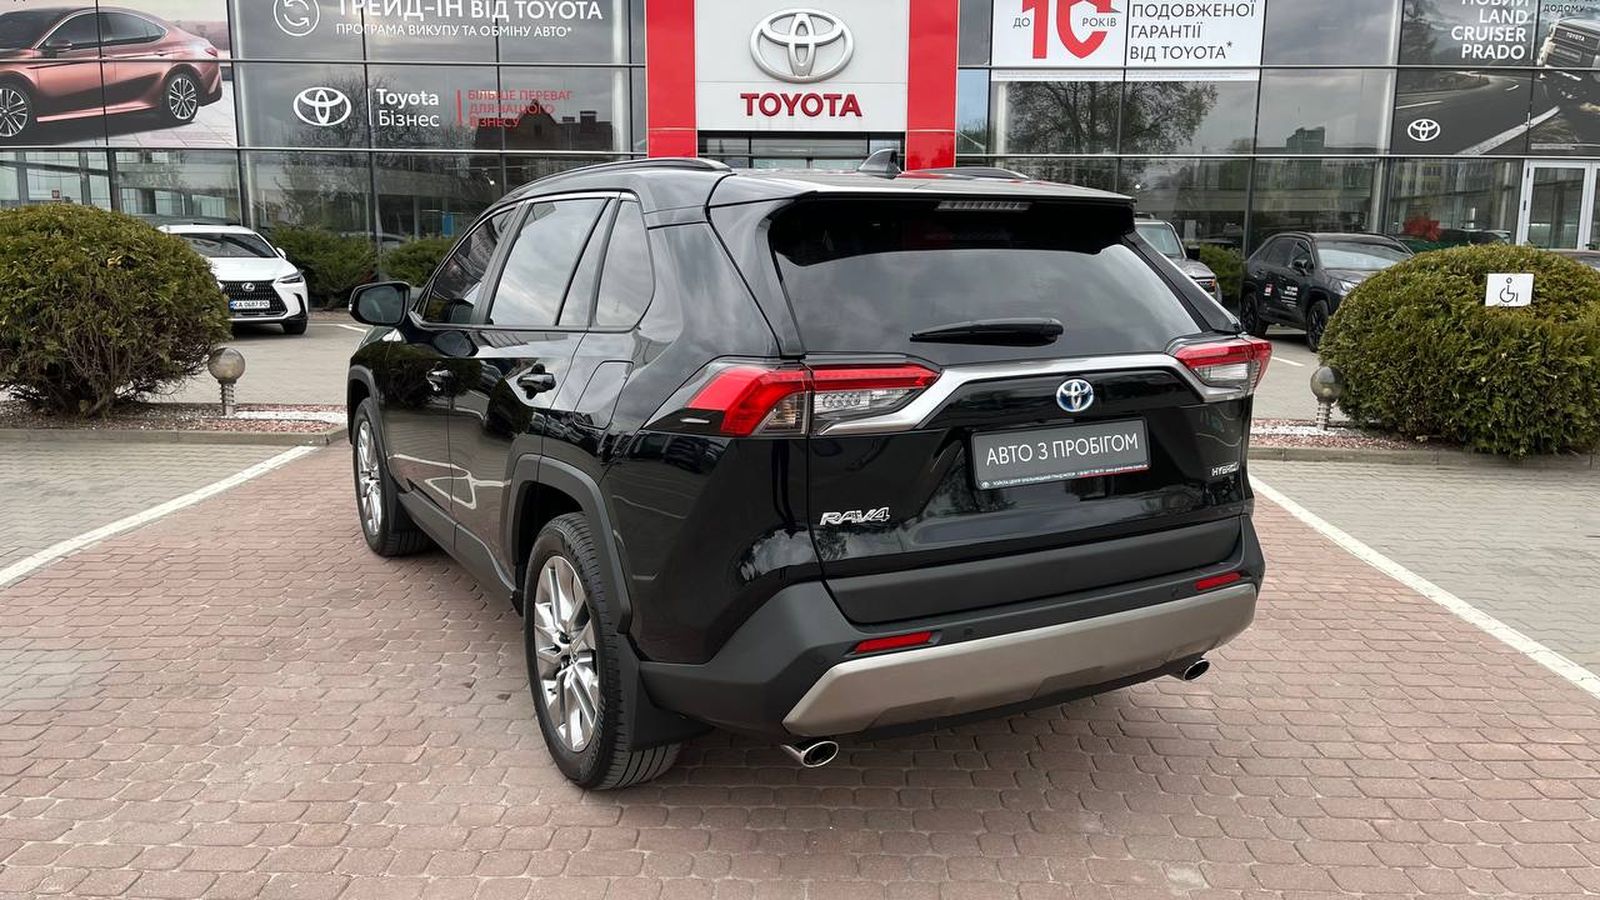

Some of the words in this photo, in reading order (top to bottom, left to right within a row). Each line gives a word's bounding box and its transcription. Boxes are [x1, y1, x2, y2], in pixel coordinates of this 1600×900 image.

[471, 0, 510, 23] ВІД
[514, 1, 603, 20] TOYOTA
[1132, 0, 1257, 20] ПОДОВЖЕНОЇ
[1479, 8, 1528, 24] LAND
[336, 23, 405, 36] ПРОГРАМА
[408, 24, 460, 36] ВИКУПУ
[461, 25, 477, 36] ТА
[479, 25, 532, 37] ОБМІНУ
[1013, 18, 1031, 29] ДО
[1082, 17, 1117, 27] РОКІВ
[1130, 22, 1204, 39] ГАРАНТІЇ
[1451, 25, 1527, 42] CRUISER
[1130, 45, 1156, 62] ВІД
[1461, 43, 1526, 60] PRADO
[375, 88, 439, 109] Toyota
[520, 89, 573, 101] ПЕРЕВАГ
[739, 92, 863, 118] TOYOTA
[379, 109, 440, 127] Бізнес
[986, 444, 1033, 466] АВТО
[1053, 432, 1139, 458] ПРОБІГОМ
[819, 506, 891, 526] RAV4
